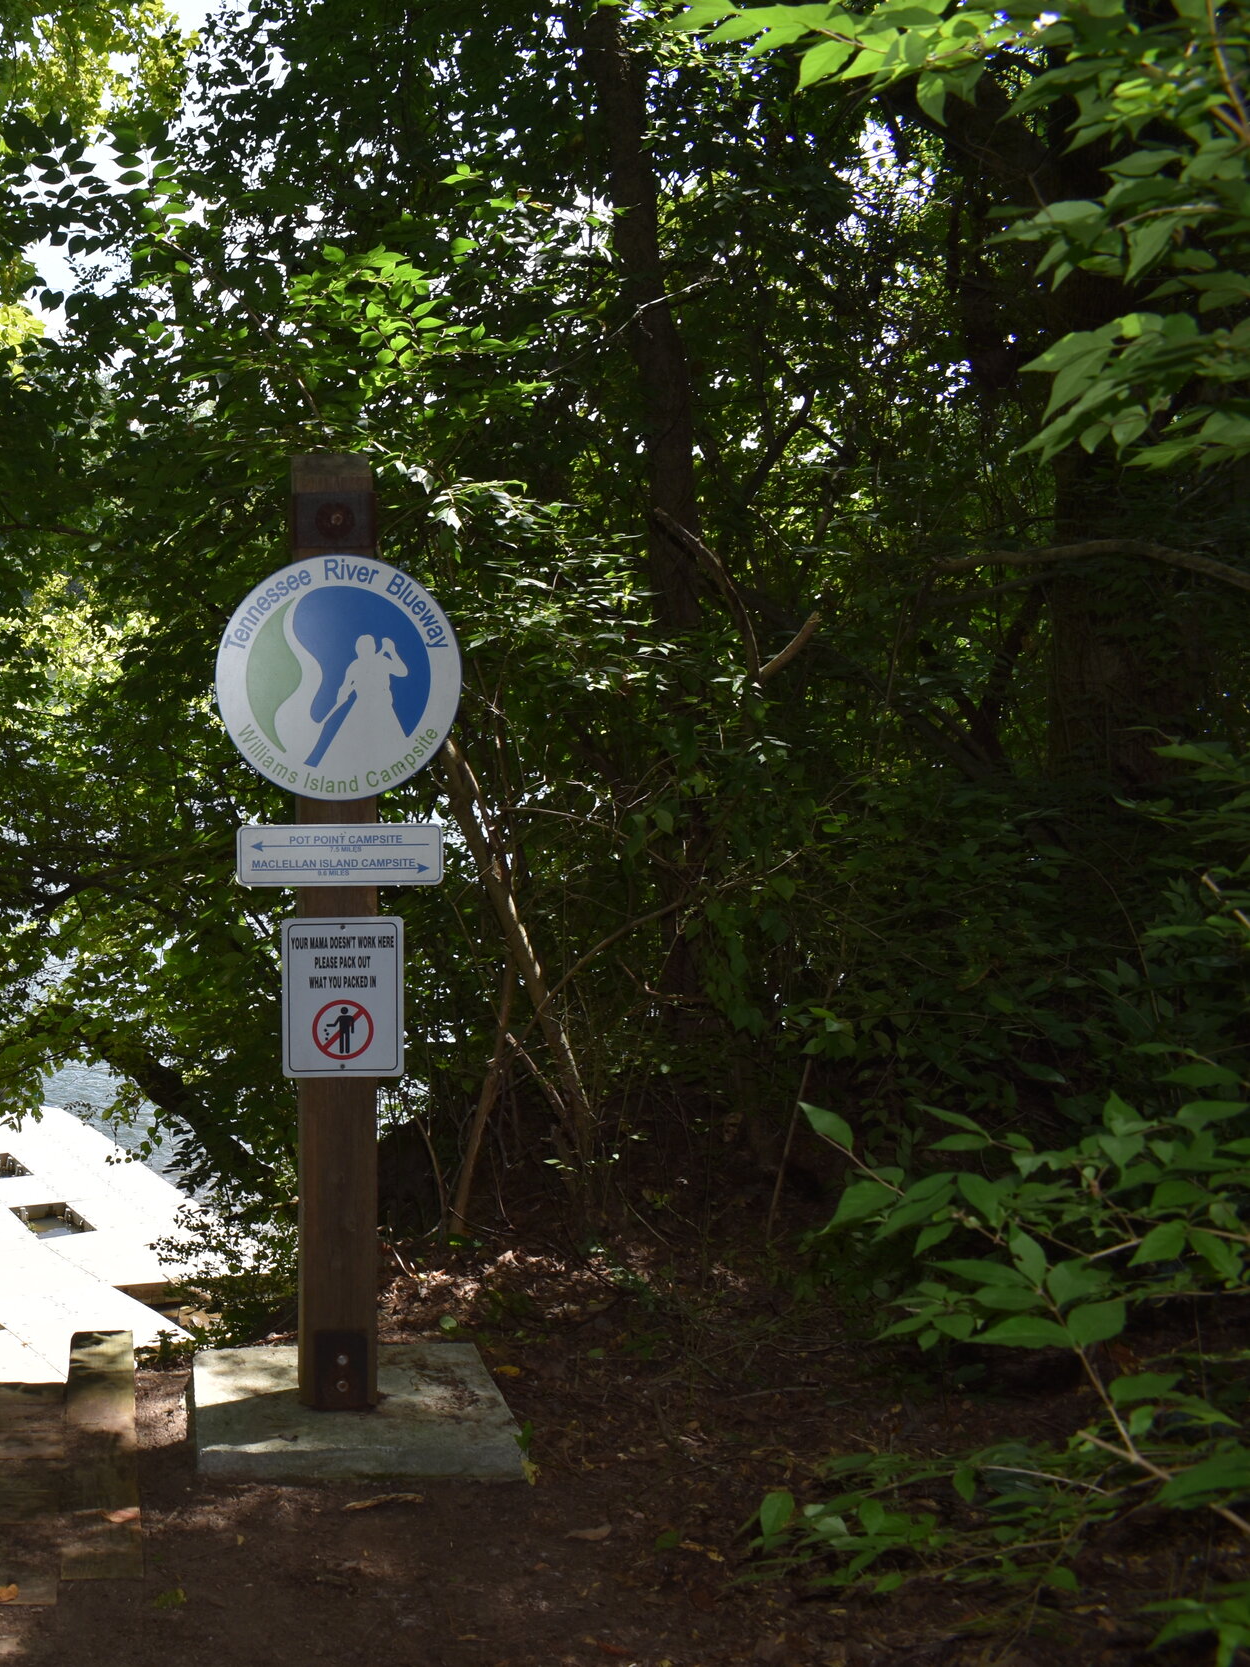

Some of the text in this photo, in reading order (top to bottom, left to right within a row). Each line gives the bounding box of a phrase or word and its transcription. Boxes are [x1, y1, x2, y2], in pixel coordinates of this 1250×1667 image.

[224, 558, 449, 650] Tennessee River Blueway
[237, 723, 438, 792] Williams Island Campsite
[289, 834, 403, 844] POT POINT CAMPSITE
[252, 858, 416, 868] MACLELLAN ISLAND CAMPSITE
[291, 935, 394, 950] YOUR MAMA DOESN'T WORK HERE
[314, 956, 371, 969] PLEASE PACK OUT
[309, 975, 377, 989] WHAT YOU PACKED IN
